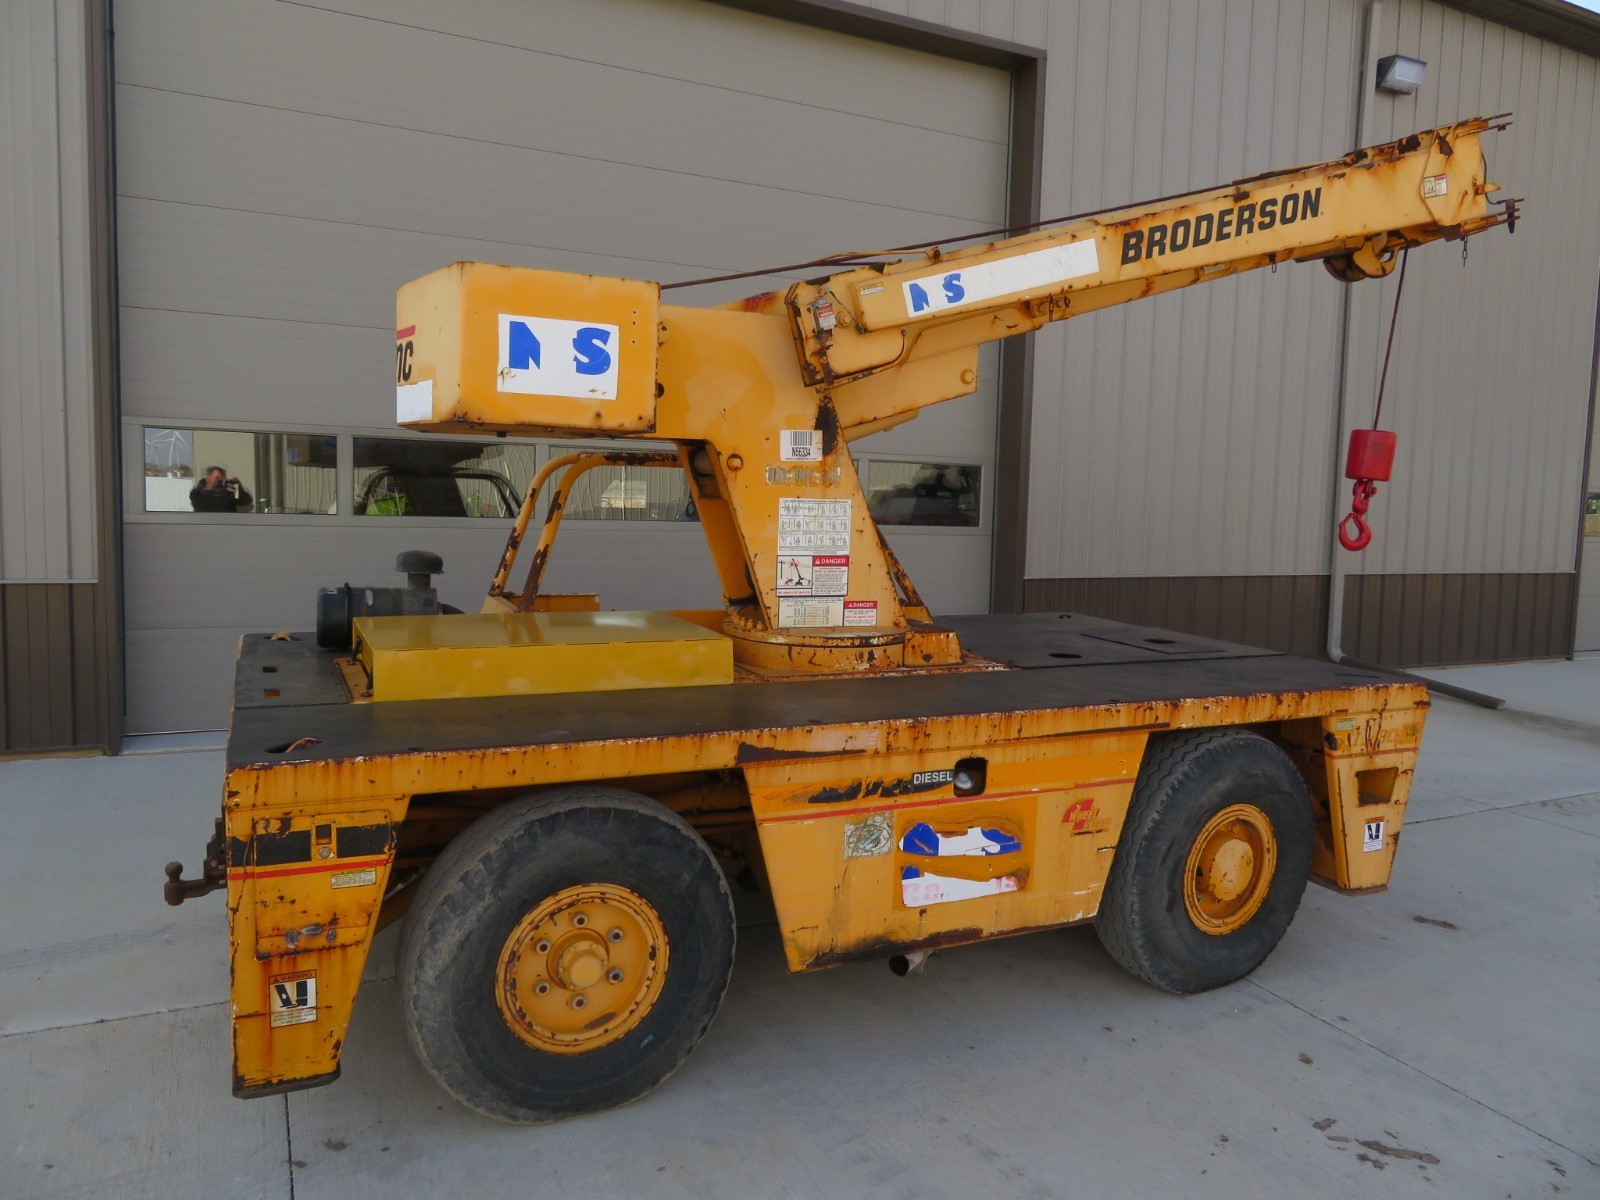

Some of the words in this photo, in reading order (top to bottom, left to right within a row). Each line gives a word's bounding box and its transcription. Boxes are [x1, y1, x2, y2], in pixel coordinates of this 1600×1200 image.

[1121, 187, 1322, 265] BRODERSON
[791, 447, 811, 457] N56334
[913, 770, 953, 785] DIESEL
